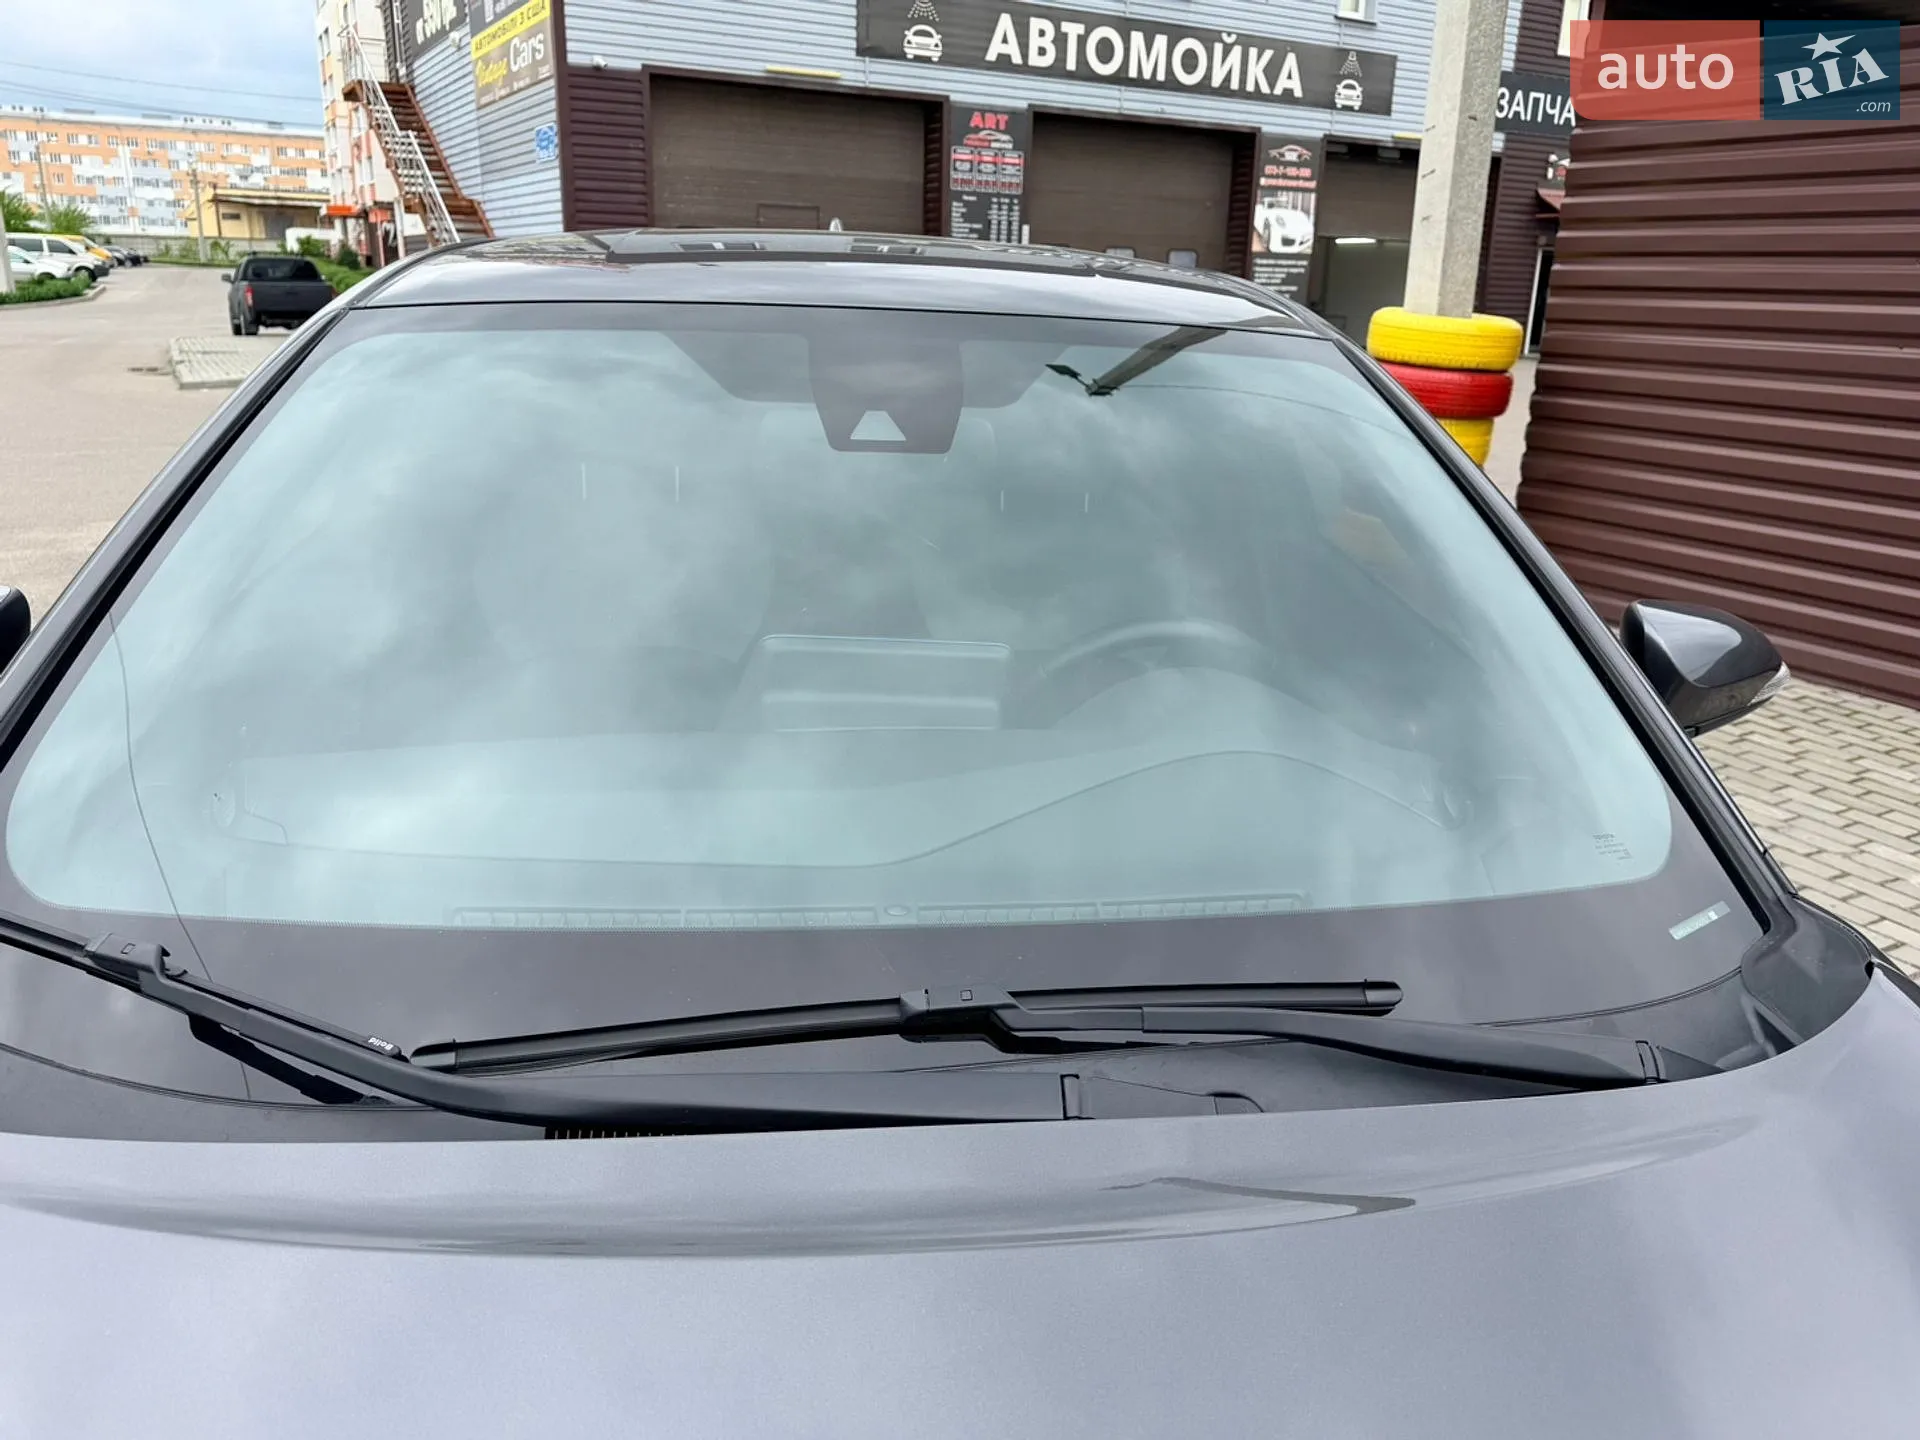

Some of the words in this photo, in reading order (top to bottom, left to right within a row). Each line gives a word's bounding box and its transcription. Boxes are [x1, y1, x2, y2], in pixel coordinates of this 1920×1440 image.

[509, 32, 545, 73] Cars
[984, 12, 1304, 98] АВТОМОЙКА
[1495, 86, 1577, 127] ЗАПЧА
